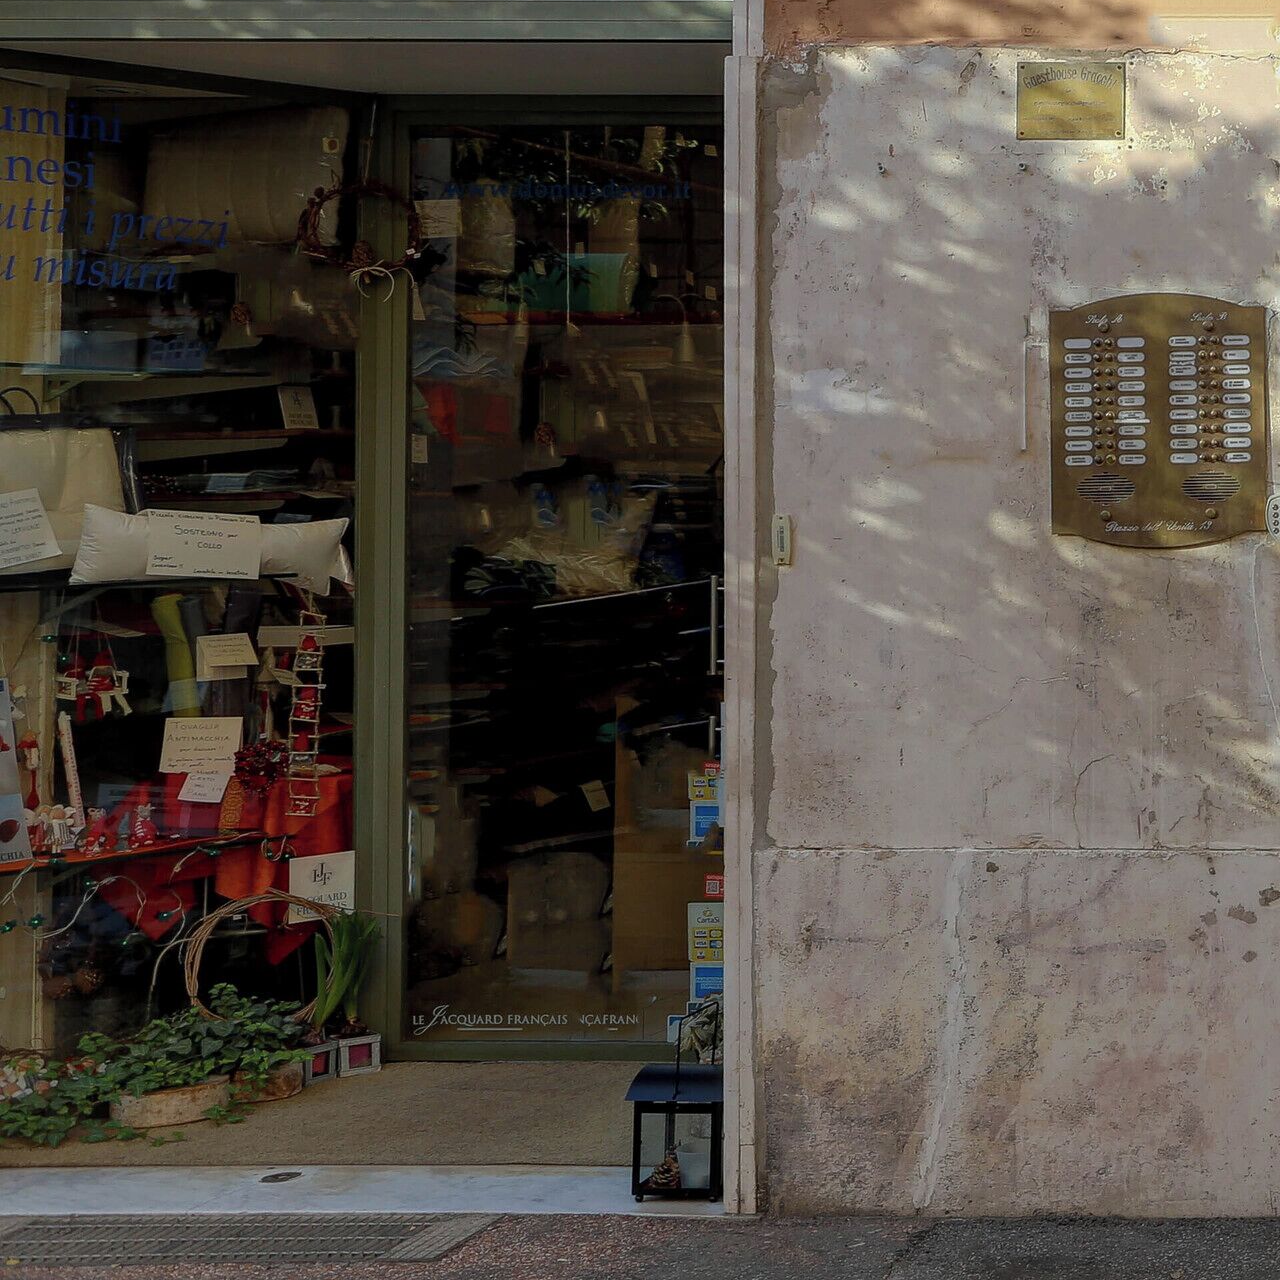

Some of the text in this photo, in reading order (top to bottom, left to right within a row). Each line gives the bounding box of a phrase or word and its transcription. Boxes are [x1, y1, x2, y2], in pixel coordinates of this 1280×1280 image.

[1022, 66, 1077, 89] Guesthouse
[106, 208, 231, 252] prezzi
[33, 248, 178, 291] misura
[412, 1014, 425, 1026] LE
[413, 1004, 503, 1036] JACQUARD
[507, 1014, 568, 1028] FRANÇAIS
